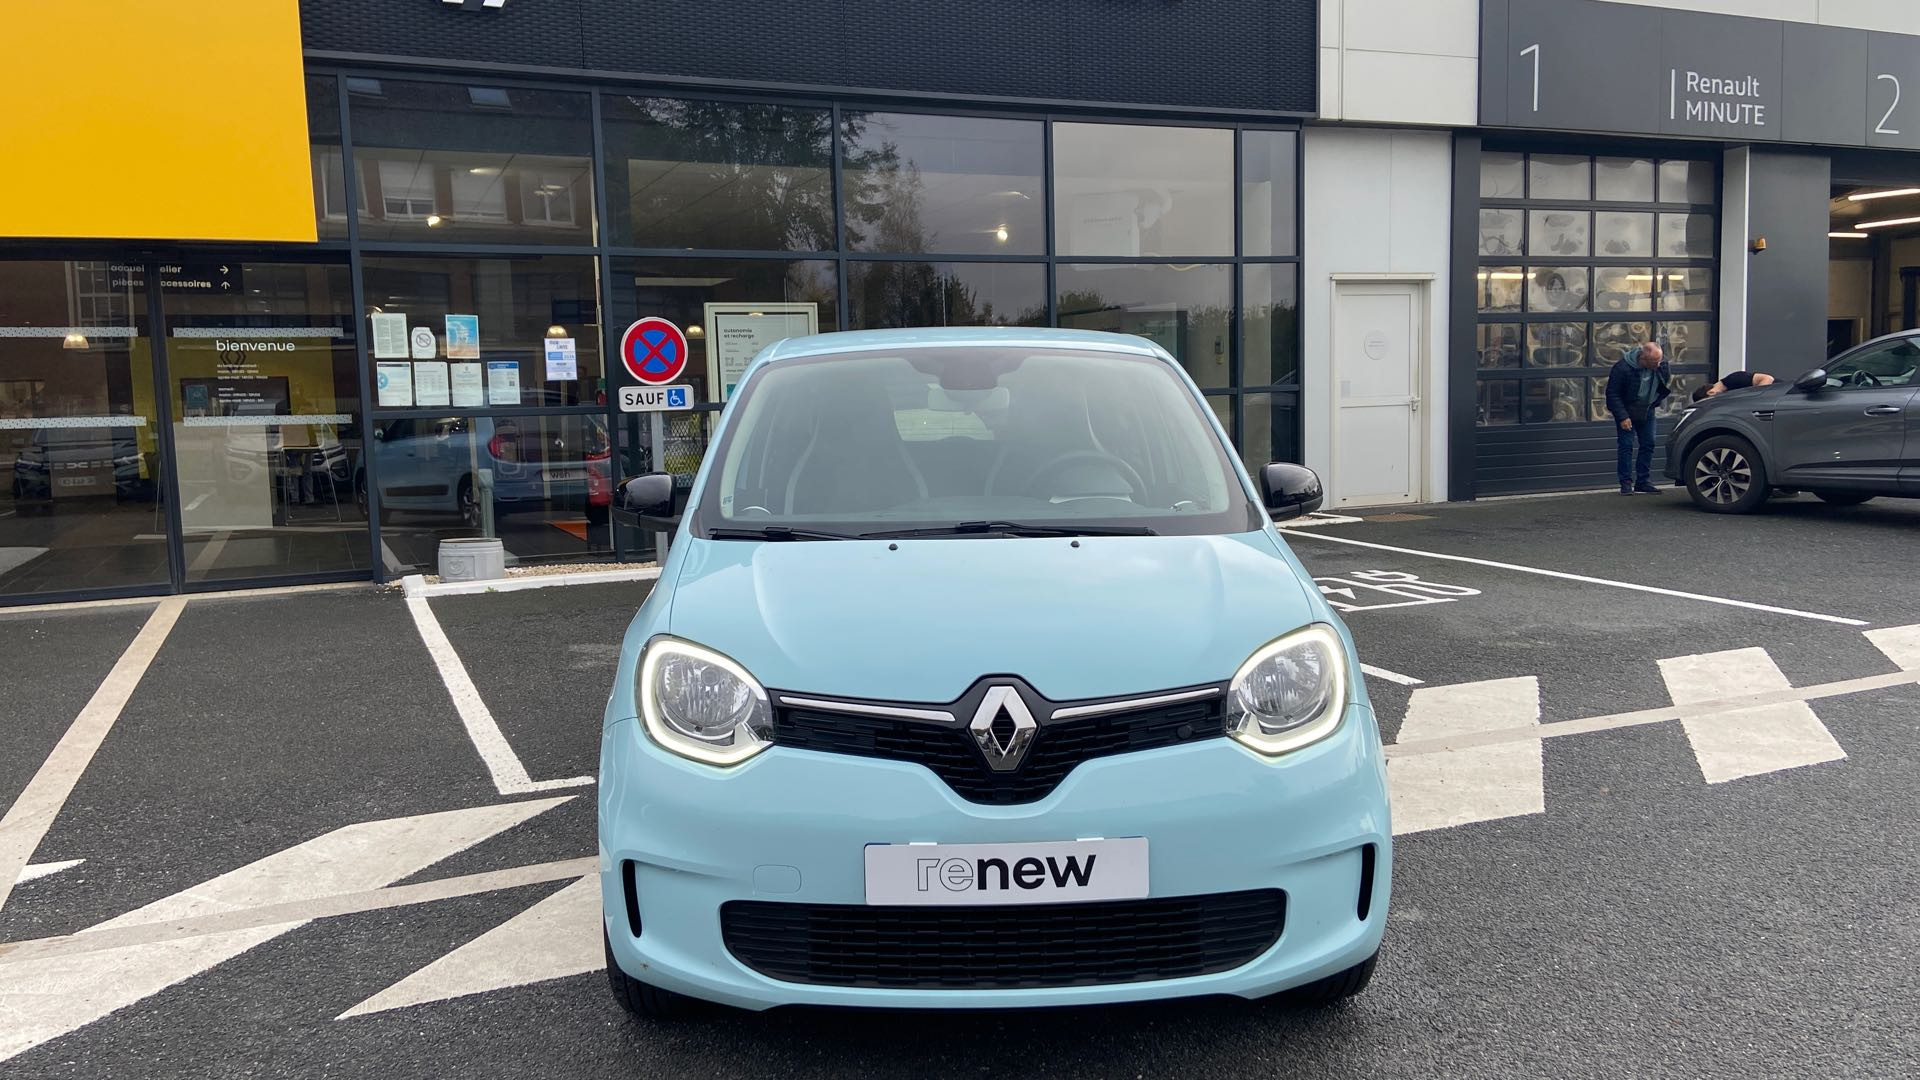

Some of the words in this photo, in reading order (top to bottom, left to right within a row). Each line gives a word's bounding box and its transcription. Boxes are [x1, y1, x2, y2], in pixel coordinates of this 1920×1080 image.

[1520, 43, 1540, 112] 1
[1686, 71, 1760, 98] Renault
[1686, 100, 1765, 125] MINUTE
[1874, 74, 1901, 135] 2
[160, 280, 212, 289] ccessoires
[215, 340, 296, 352] bienvenue
[625, 392, 665, 406] SAUF
[917, 854, 1097, 892] renew
